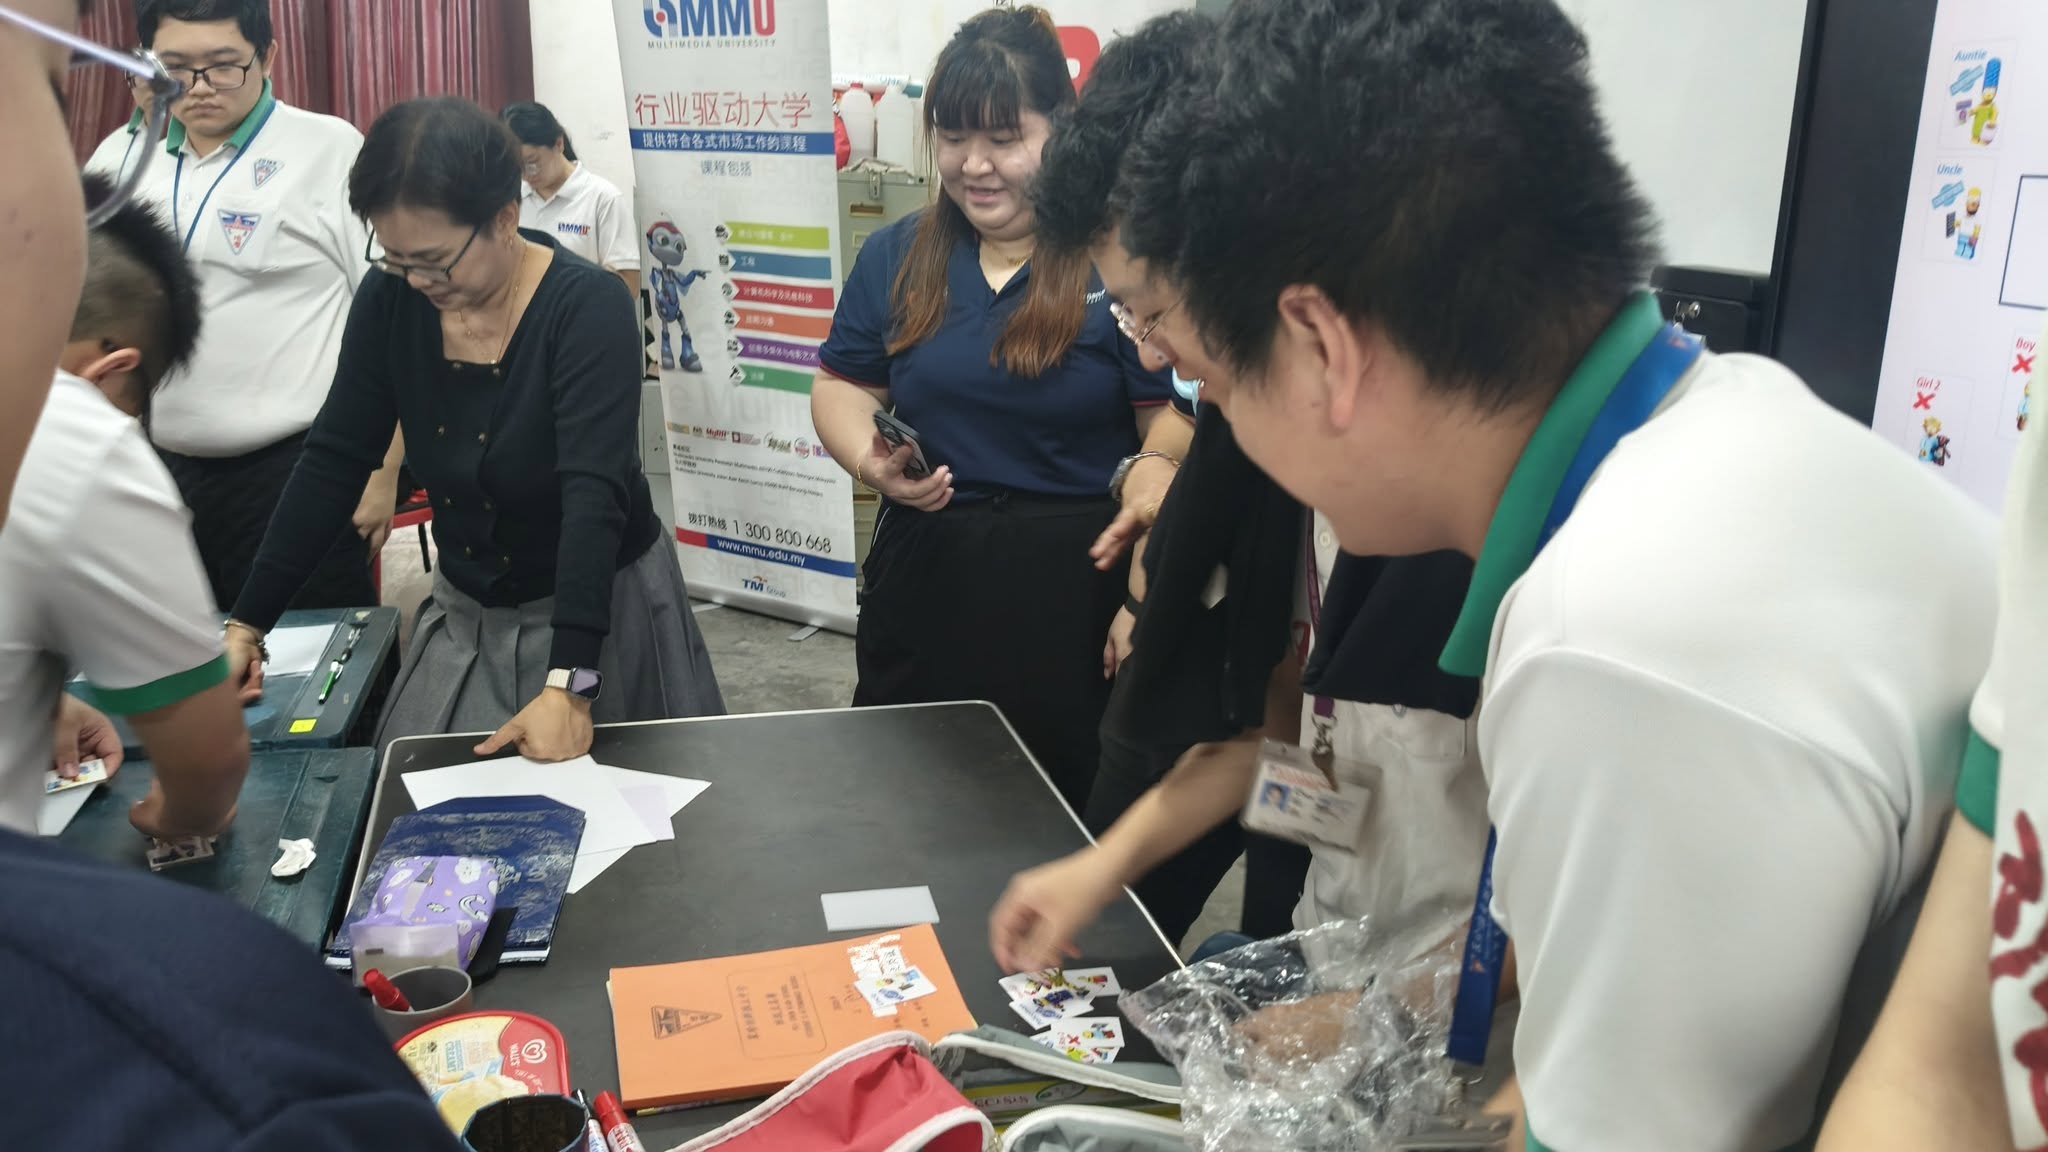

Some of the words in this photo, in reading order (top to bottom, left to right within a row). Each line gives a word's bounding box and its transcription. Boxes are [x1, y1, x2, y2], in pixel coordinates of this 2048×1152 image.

[647, 39, 712, 49] MULTIMEDIA
[717, 38, 777, 49] UNIVERSITY
[1954, 49, 1988, 63] Auntie
[635, 91, 812, 129] 行业驱动大学
[1937, 163, 1964, 176] Uncle
[2016, 337, 2036, 353] Boy
[1916, 376, 1933, 390] Girl
[1934, 381, 1941, 391] 2
[688, 512, 728, 531] 拨打热线
[732, 519, 740, 535] 1
[745, 521, 771, 542] 300
[775, 527, 802, 548] 800
[805, 533, 832, 554] 668
[717, 538, 806, 567] www.mmu.edu.my
[741, 578, 764, 592] TM
